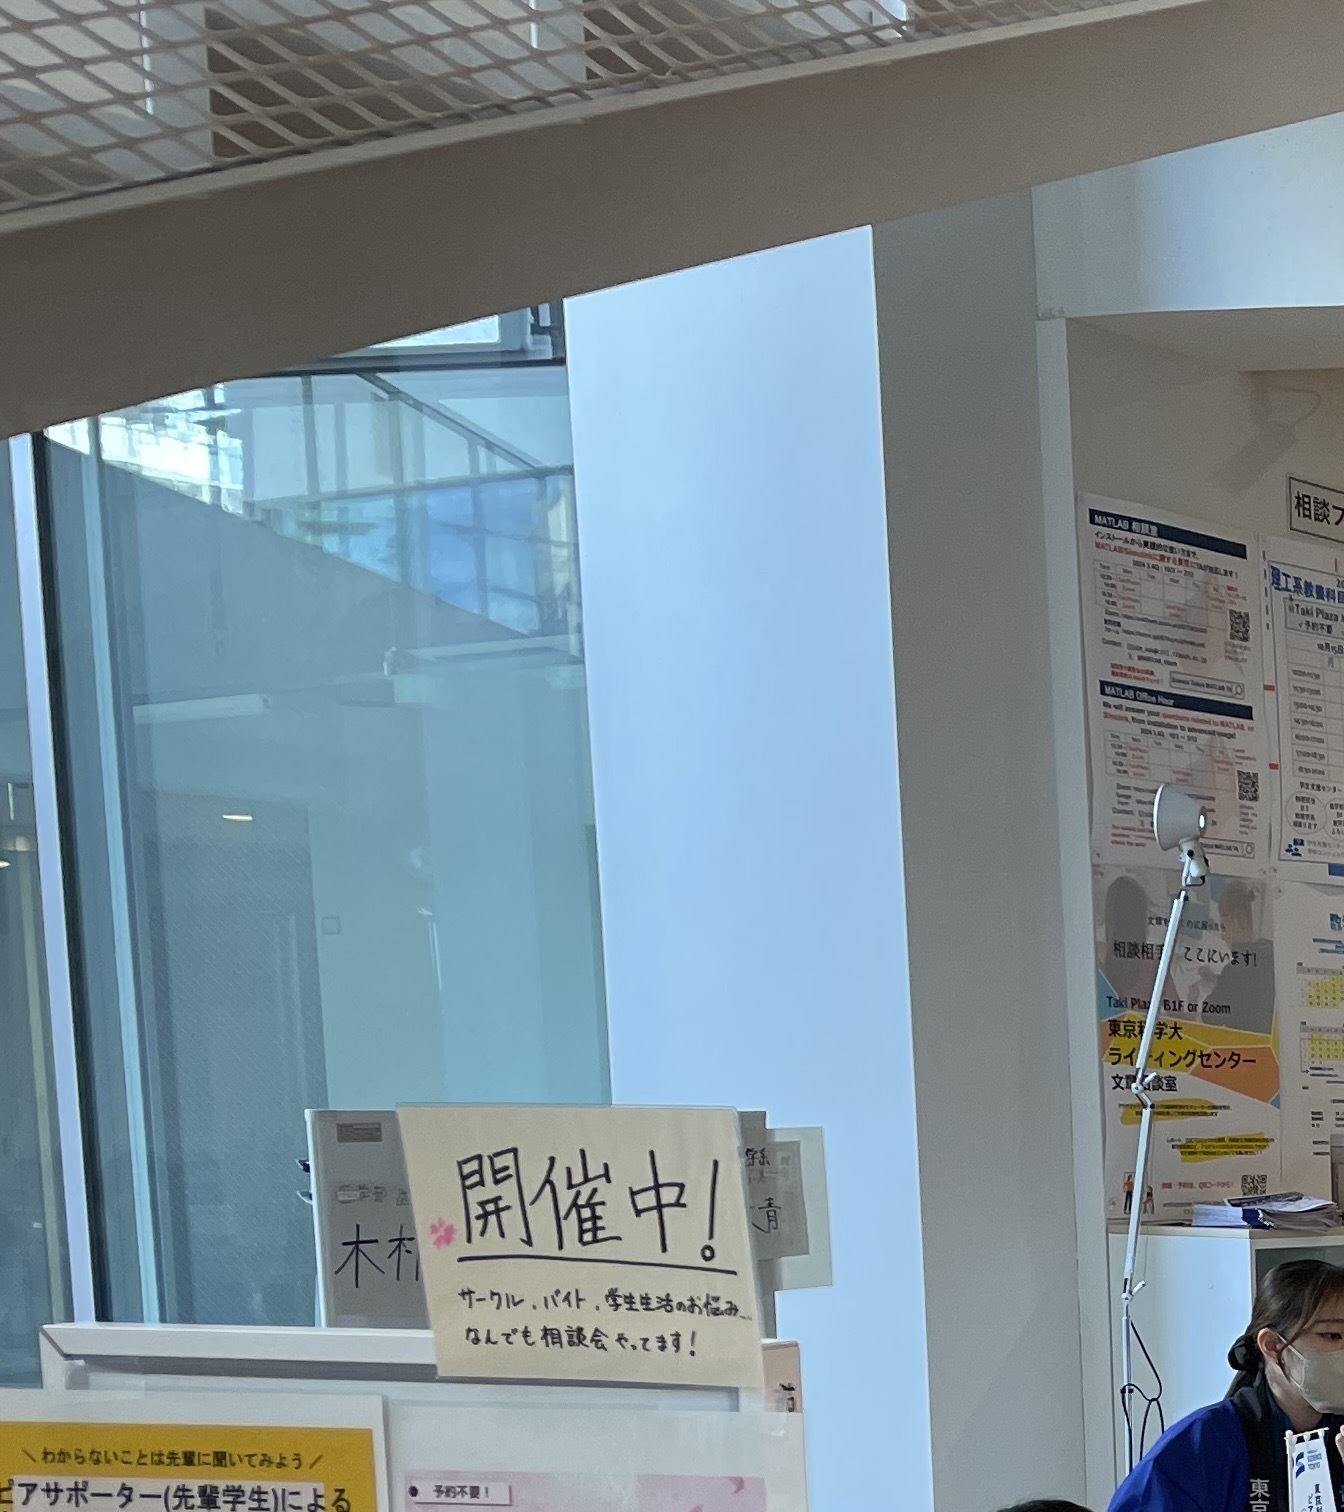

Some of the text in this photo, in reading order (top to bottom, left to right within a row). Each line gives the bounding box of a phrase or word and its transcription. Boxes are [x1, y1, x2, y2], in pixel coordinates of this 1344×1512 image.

[1094, 514, 1129, 530] MATLAB
[1106, 996, 1231, 1014] Taki B1F or Zoom
